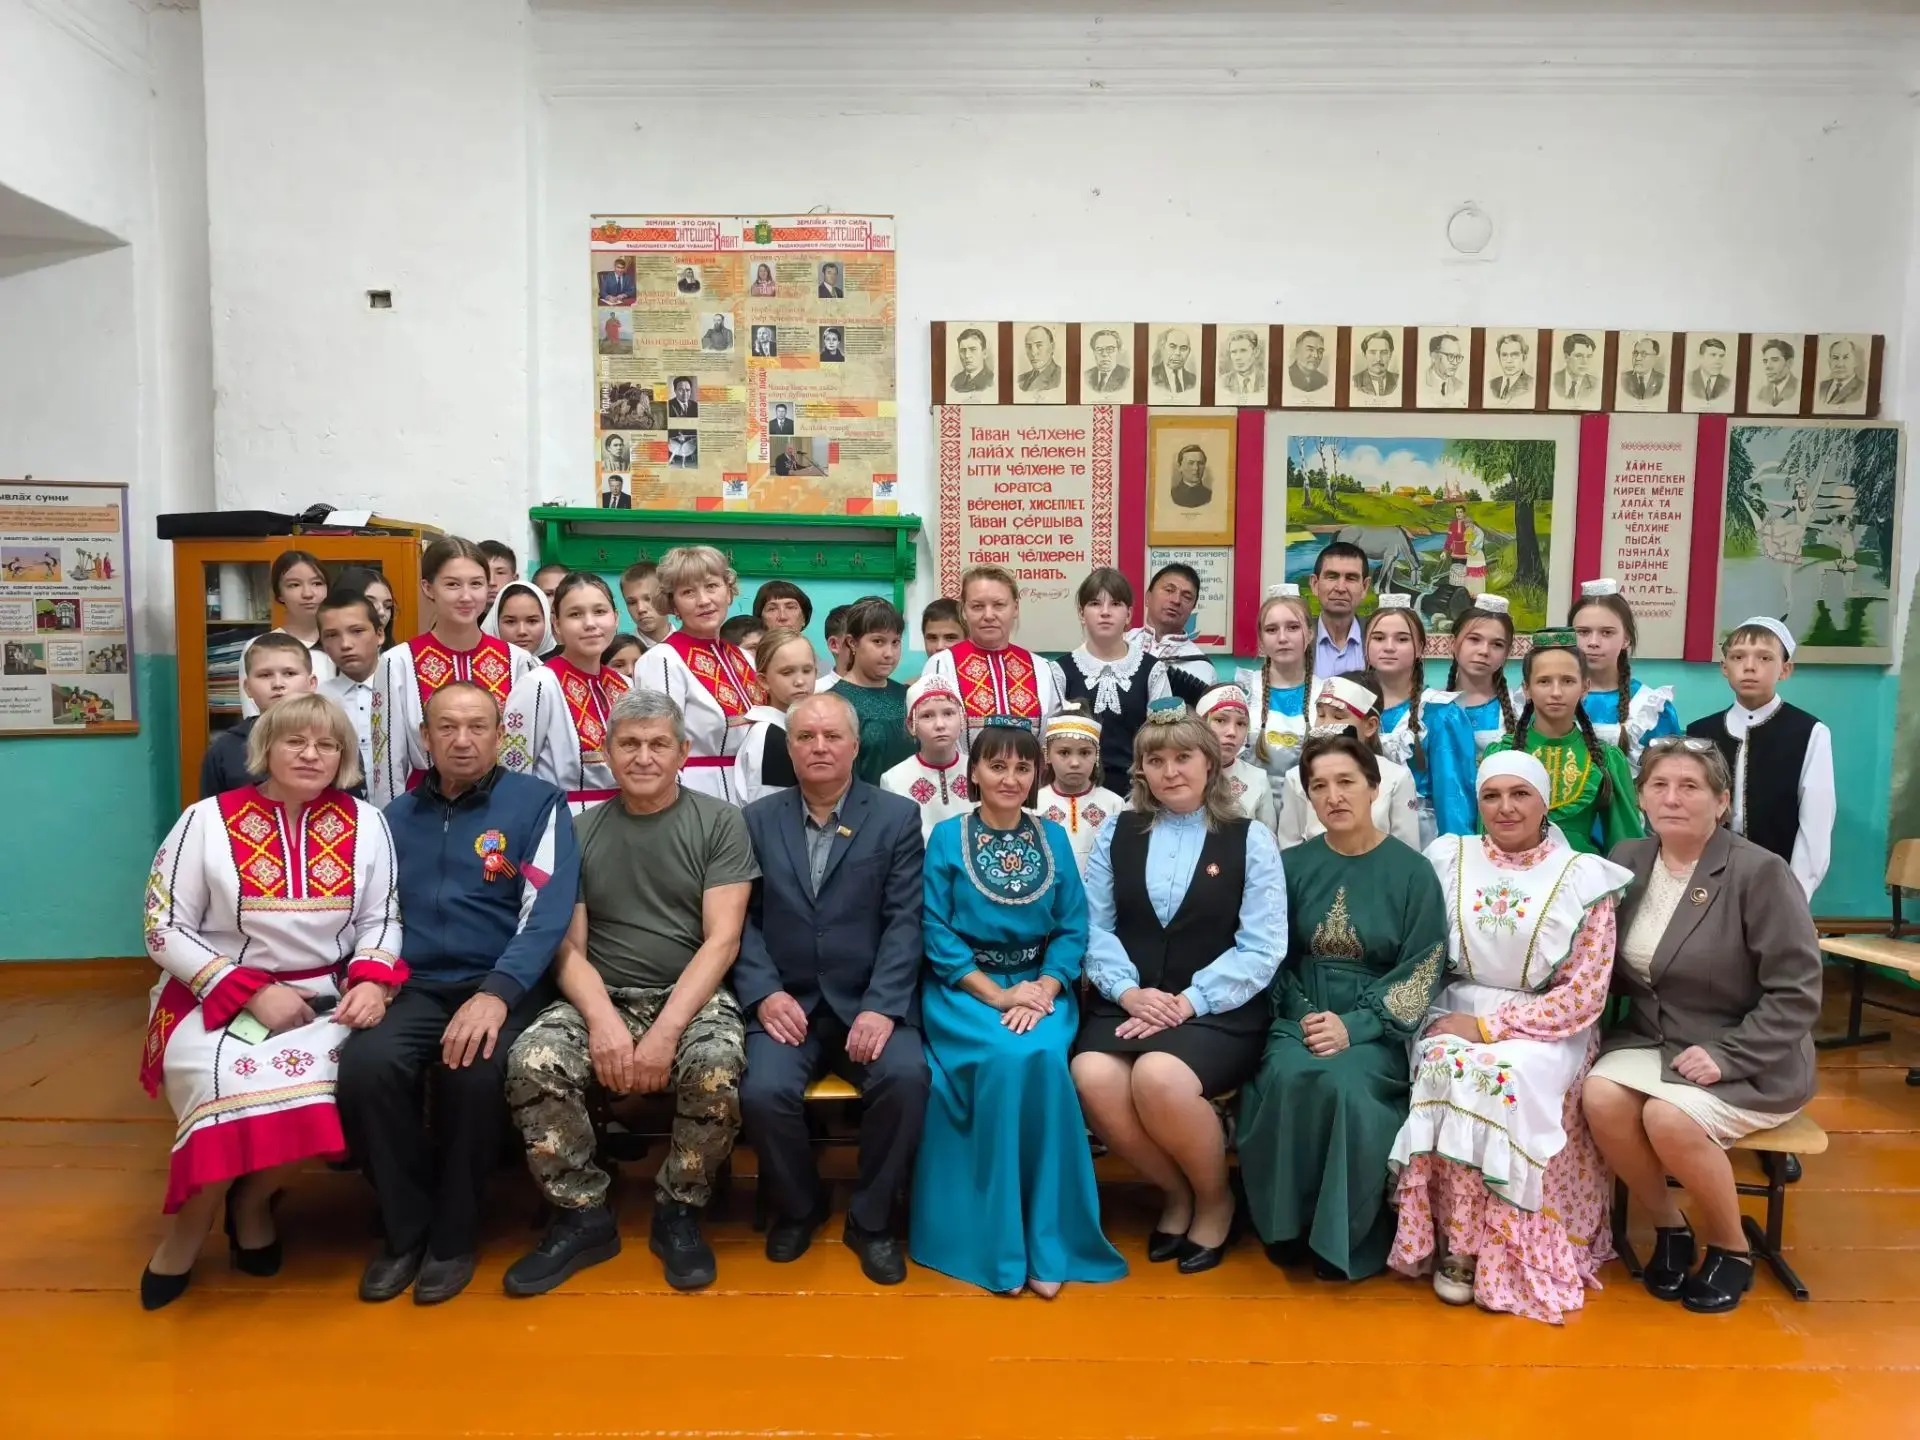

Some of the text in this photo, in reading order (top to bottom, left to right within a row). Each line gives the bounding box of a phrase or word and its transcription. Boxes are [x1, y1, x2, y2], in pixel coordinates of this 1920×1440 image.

[1070, 464, 1086, 476] те
[1659, 499, 1671, 508] ТА
[1058, 534, 1074, 545] те
[1014, 568, 1067, 580] ланать.
[1624, 573, 1658, 582] ХУРСА
